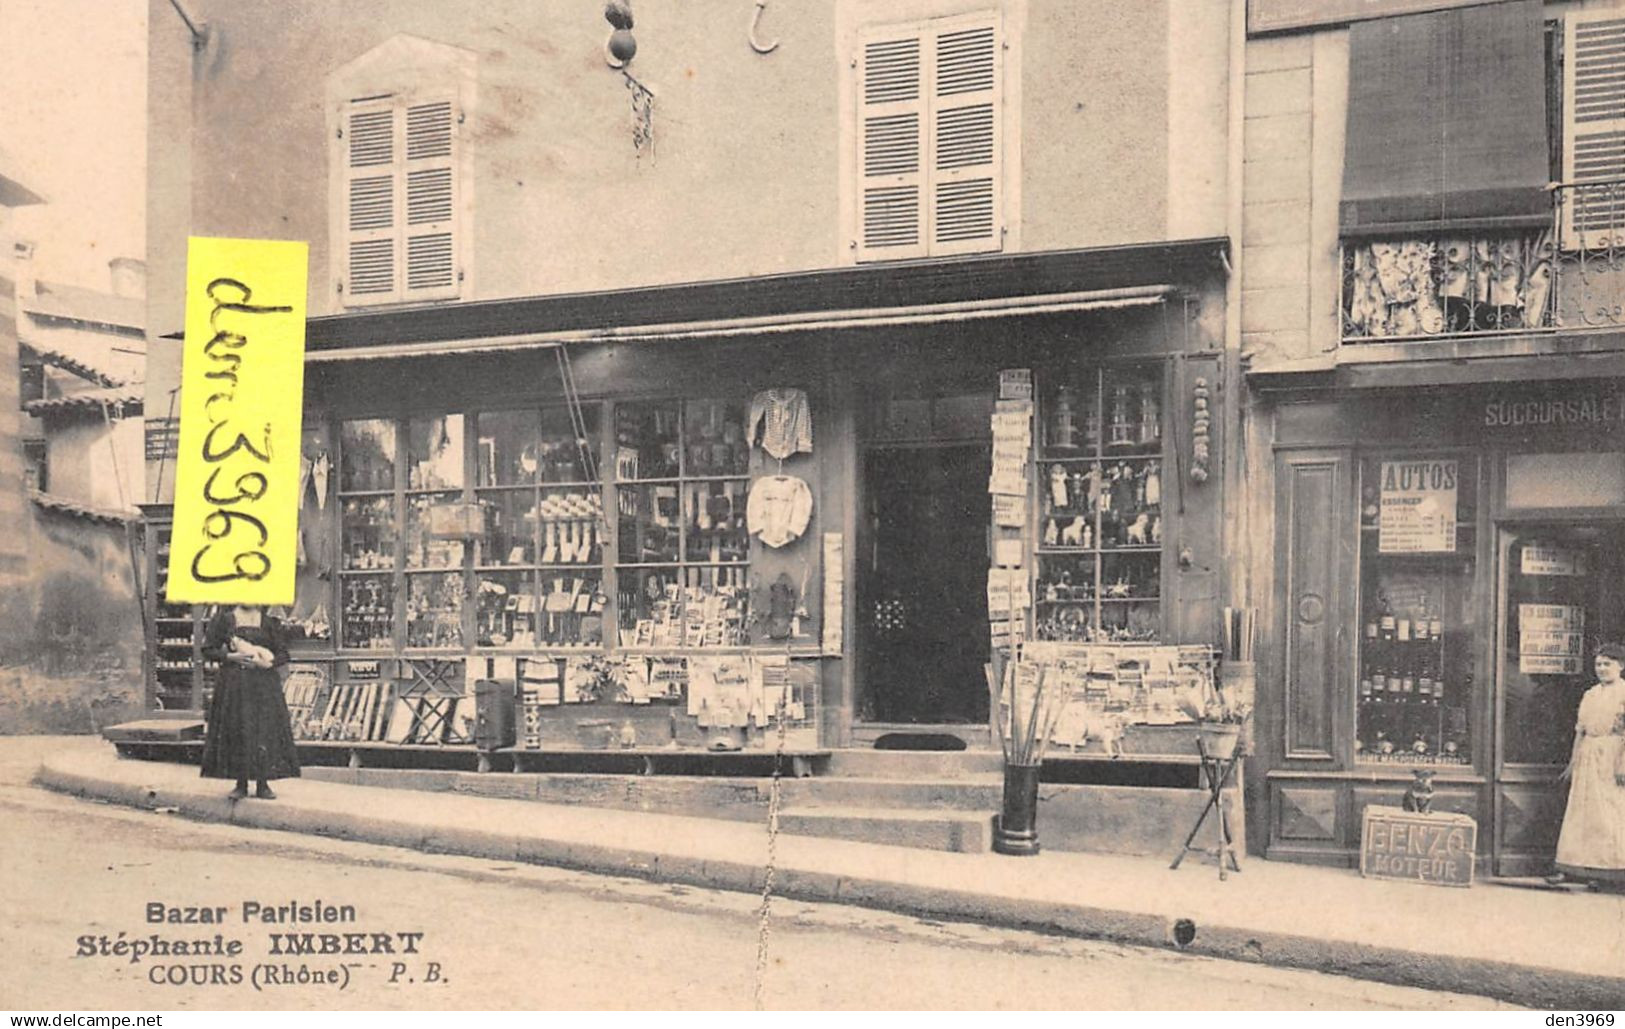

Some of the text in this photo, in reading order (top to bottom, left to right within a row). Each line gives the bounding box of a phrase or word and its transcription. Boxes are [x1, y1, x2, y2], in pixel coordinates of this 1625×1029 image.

[1485, 398, 1615, 427] SUCCURSALE
[1383, 462, 1456, 492] AUTOS
[1369, 821, 1465, 857] BENZO
[1375, 855, 1457, 880] MOTEUR
